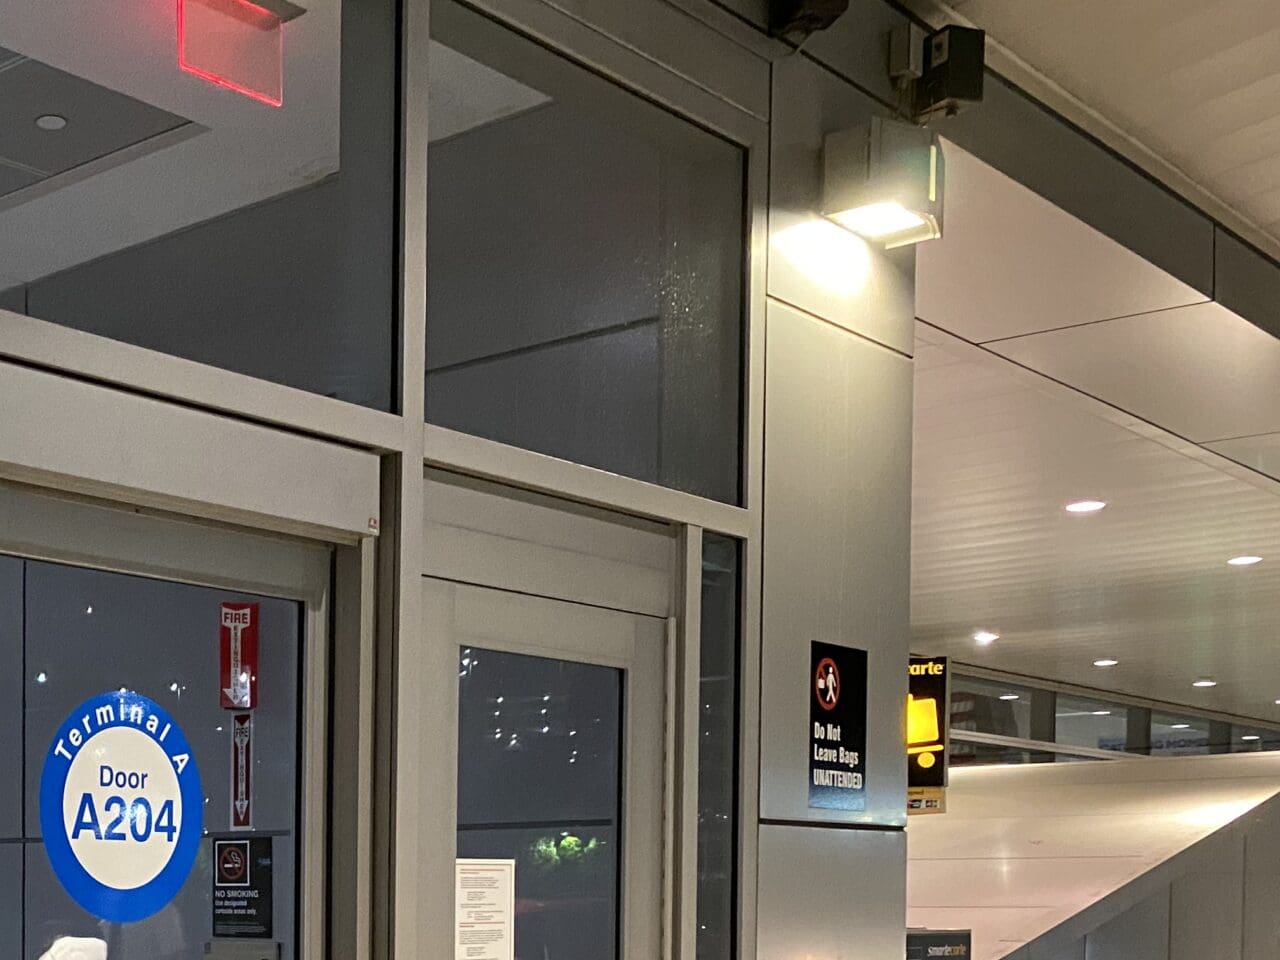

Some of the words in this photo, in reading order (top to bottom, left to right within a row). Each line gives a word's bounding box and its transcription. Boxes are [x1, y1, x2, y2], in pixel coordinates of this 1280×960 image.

[224, 612, 248, 624] FIRE
[908, 661, 944, 675] arte
[54, 698, 171, 760] Terminal
[172, 753, 190, 774] A
[814, 721, 825, 739] Do
[827, 723, 841, 741] Not
[814, 744, 837, 762] Leave
[839, 746, 859, 768] Bags
[100, 765, 148, 789] Door
[814, 768, 862, 789] UNATTENDED
[71, 793, 176, 842] A204
[215, 890, 225, 898] NO
[226, 890, 259, 898] SMOKING
